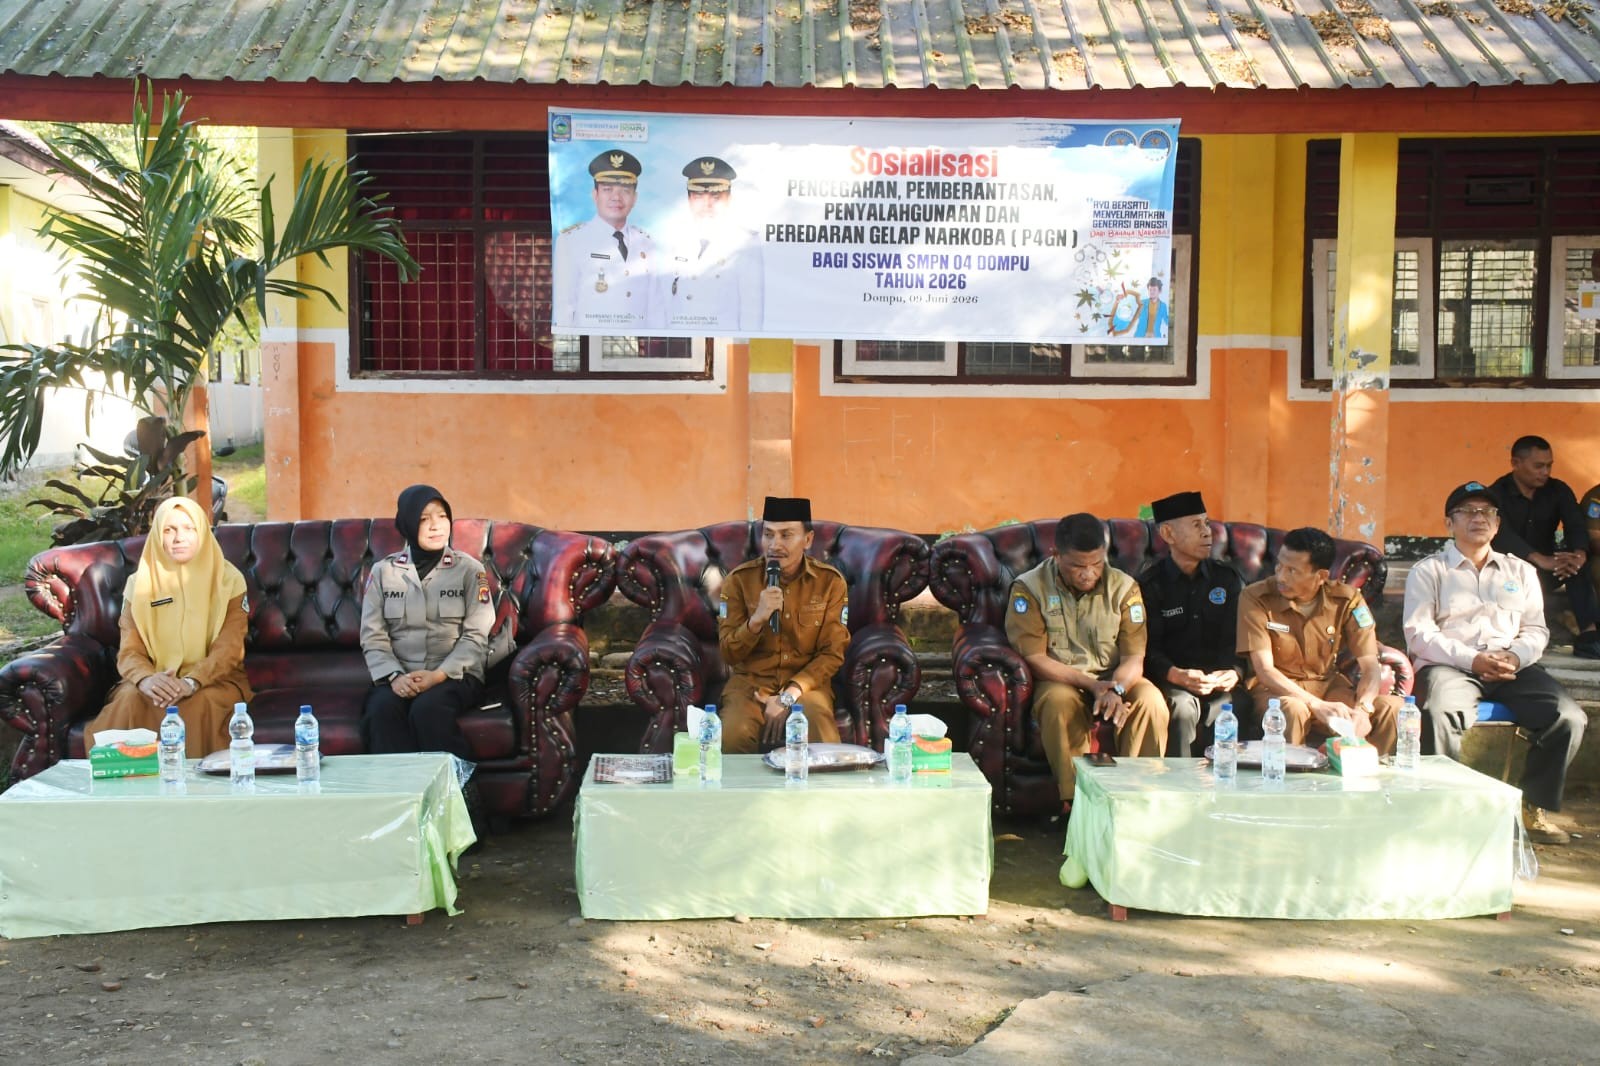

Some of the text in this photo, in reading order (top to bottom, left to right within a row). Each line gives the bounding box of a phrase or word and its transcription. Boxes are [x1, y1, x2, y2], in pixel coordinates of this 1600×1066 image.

[850, 146, 998, 178] Sosialisasi
[788, 179, 1058, 202] PENCEGAHAN, PEMBERANTASAN,
[824, 203, 1020, 223] PENYALAHGUNAAN DAN
[1112, 200, 1149, 210] BERSATU
[1092, 210, 1166, 219] MENYELAMATKAN
[1092, 219, 1168, 229] GENERASI BANGSA
[766, 224, 865, 244] PEREDARAN
[869, 226, 921, 245] GELAP
[925, 227, 1006, 246] NARKOBA
[1022, 229, 1067, 247] P4GN
[812, 251, 1030, 272] BAGI SISWA SMPN 04 DOMPU
[874, 272, 966, 289] TAHUN 2026
[863, 292, 979, 305] Dompu, 09 Juni 2026
[440, 589, 465, 598] POLR
